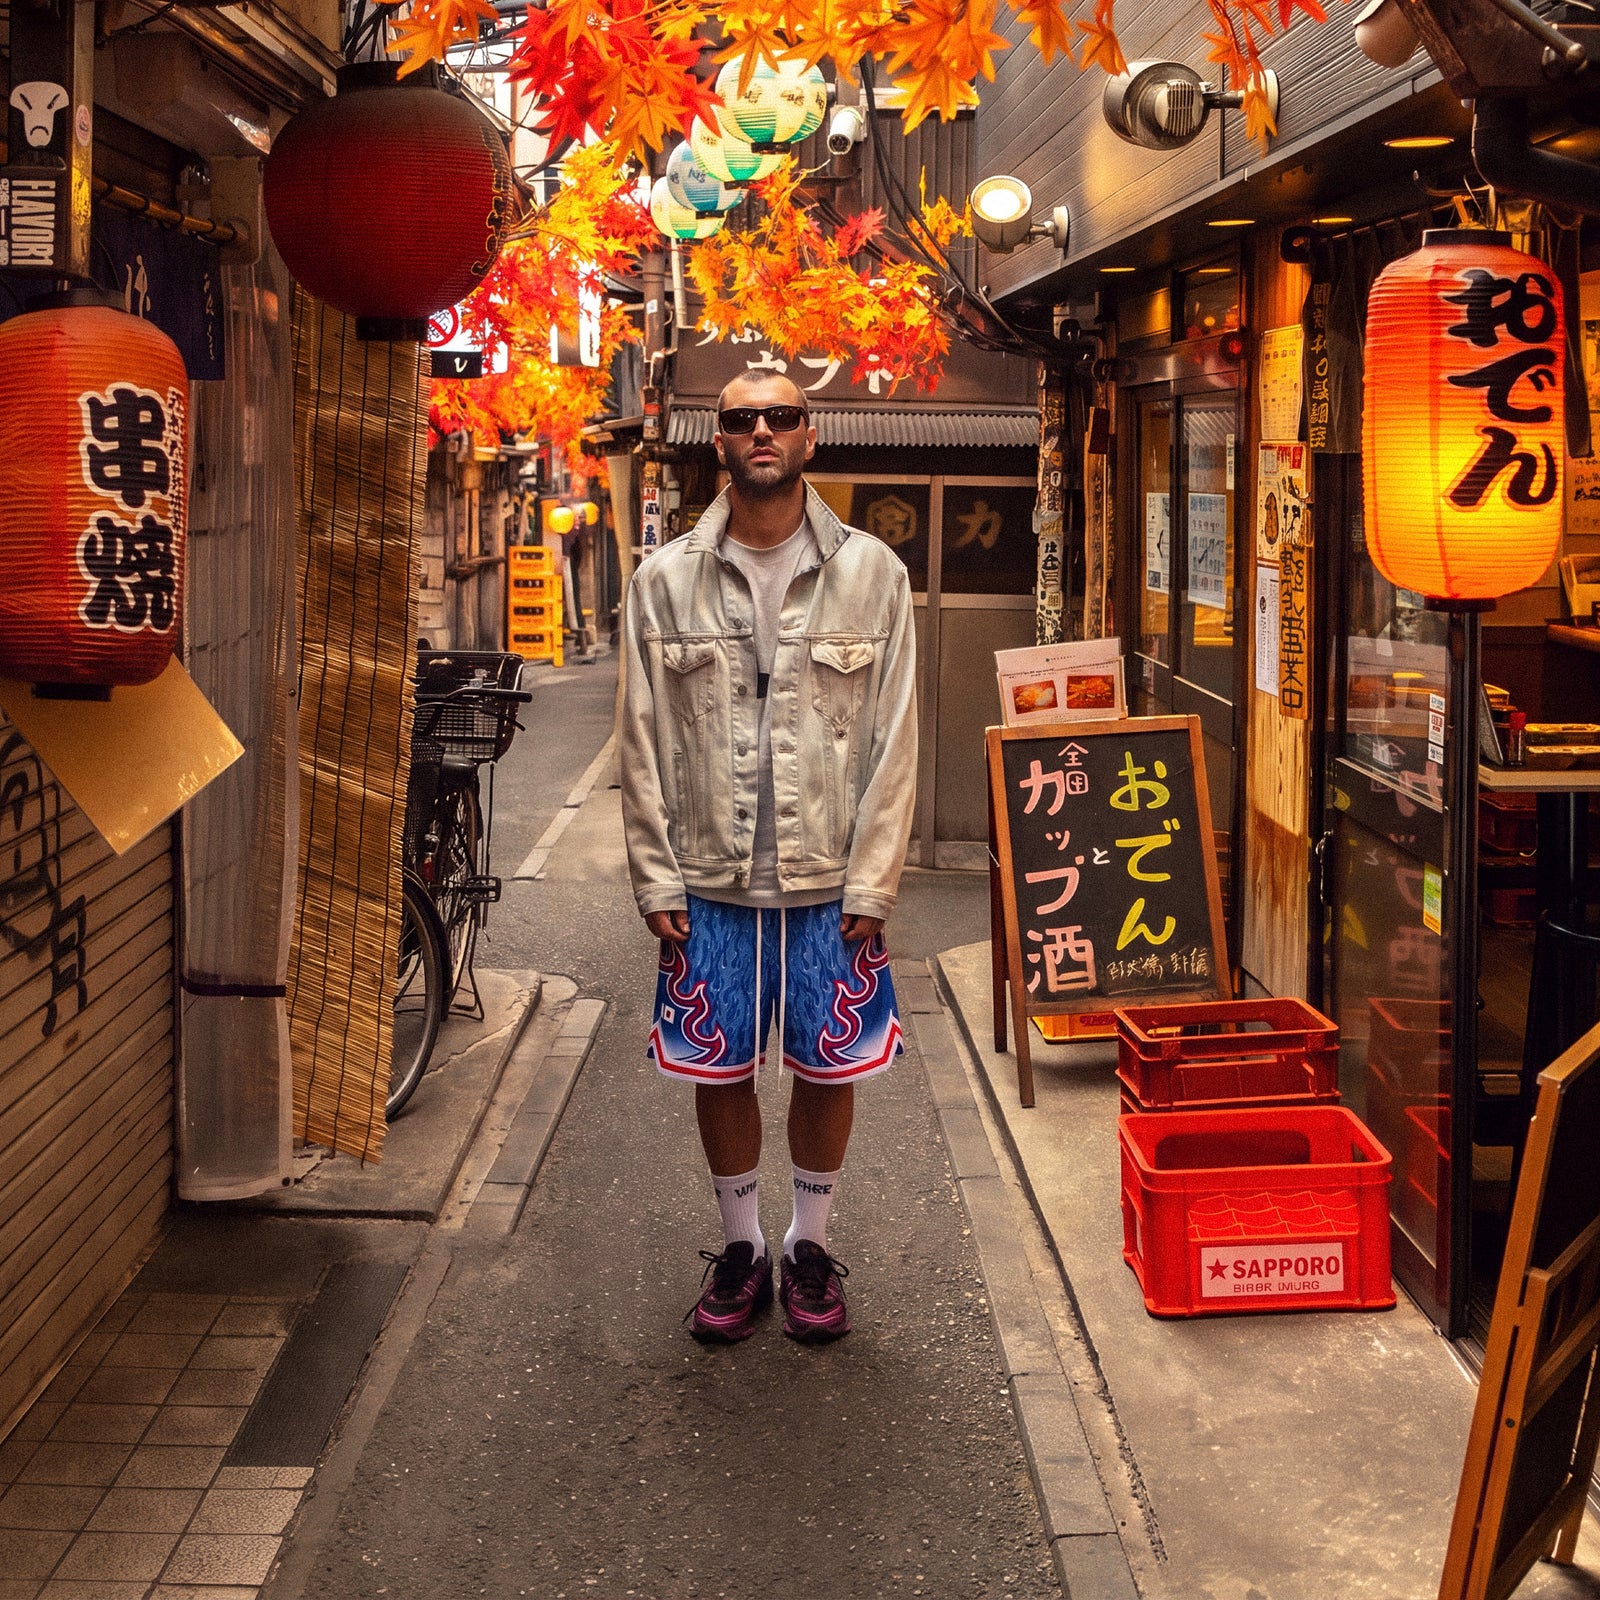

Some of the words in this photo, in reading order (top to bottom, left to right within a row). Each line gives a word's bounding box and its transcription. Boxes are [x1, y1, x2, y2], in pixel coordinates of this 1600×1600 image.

[1440, 268, 1557, 507] おでん
[1093, 847, 1111, 865] と
[1110, 751, 1181, 950] おでん
[1232, 1256, 1340, 1279] SAPPORO
